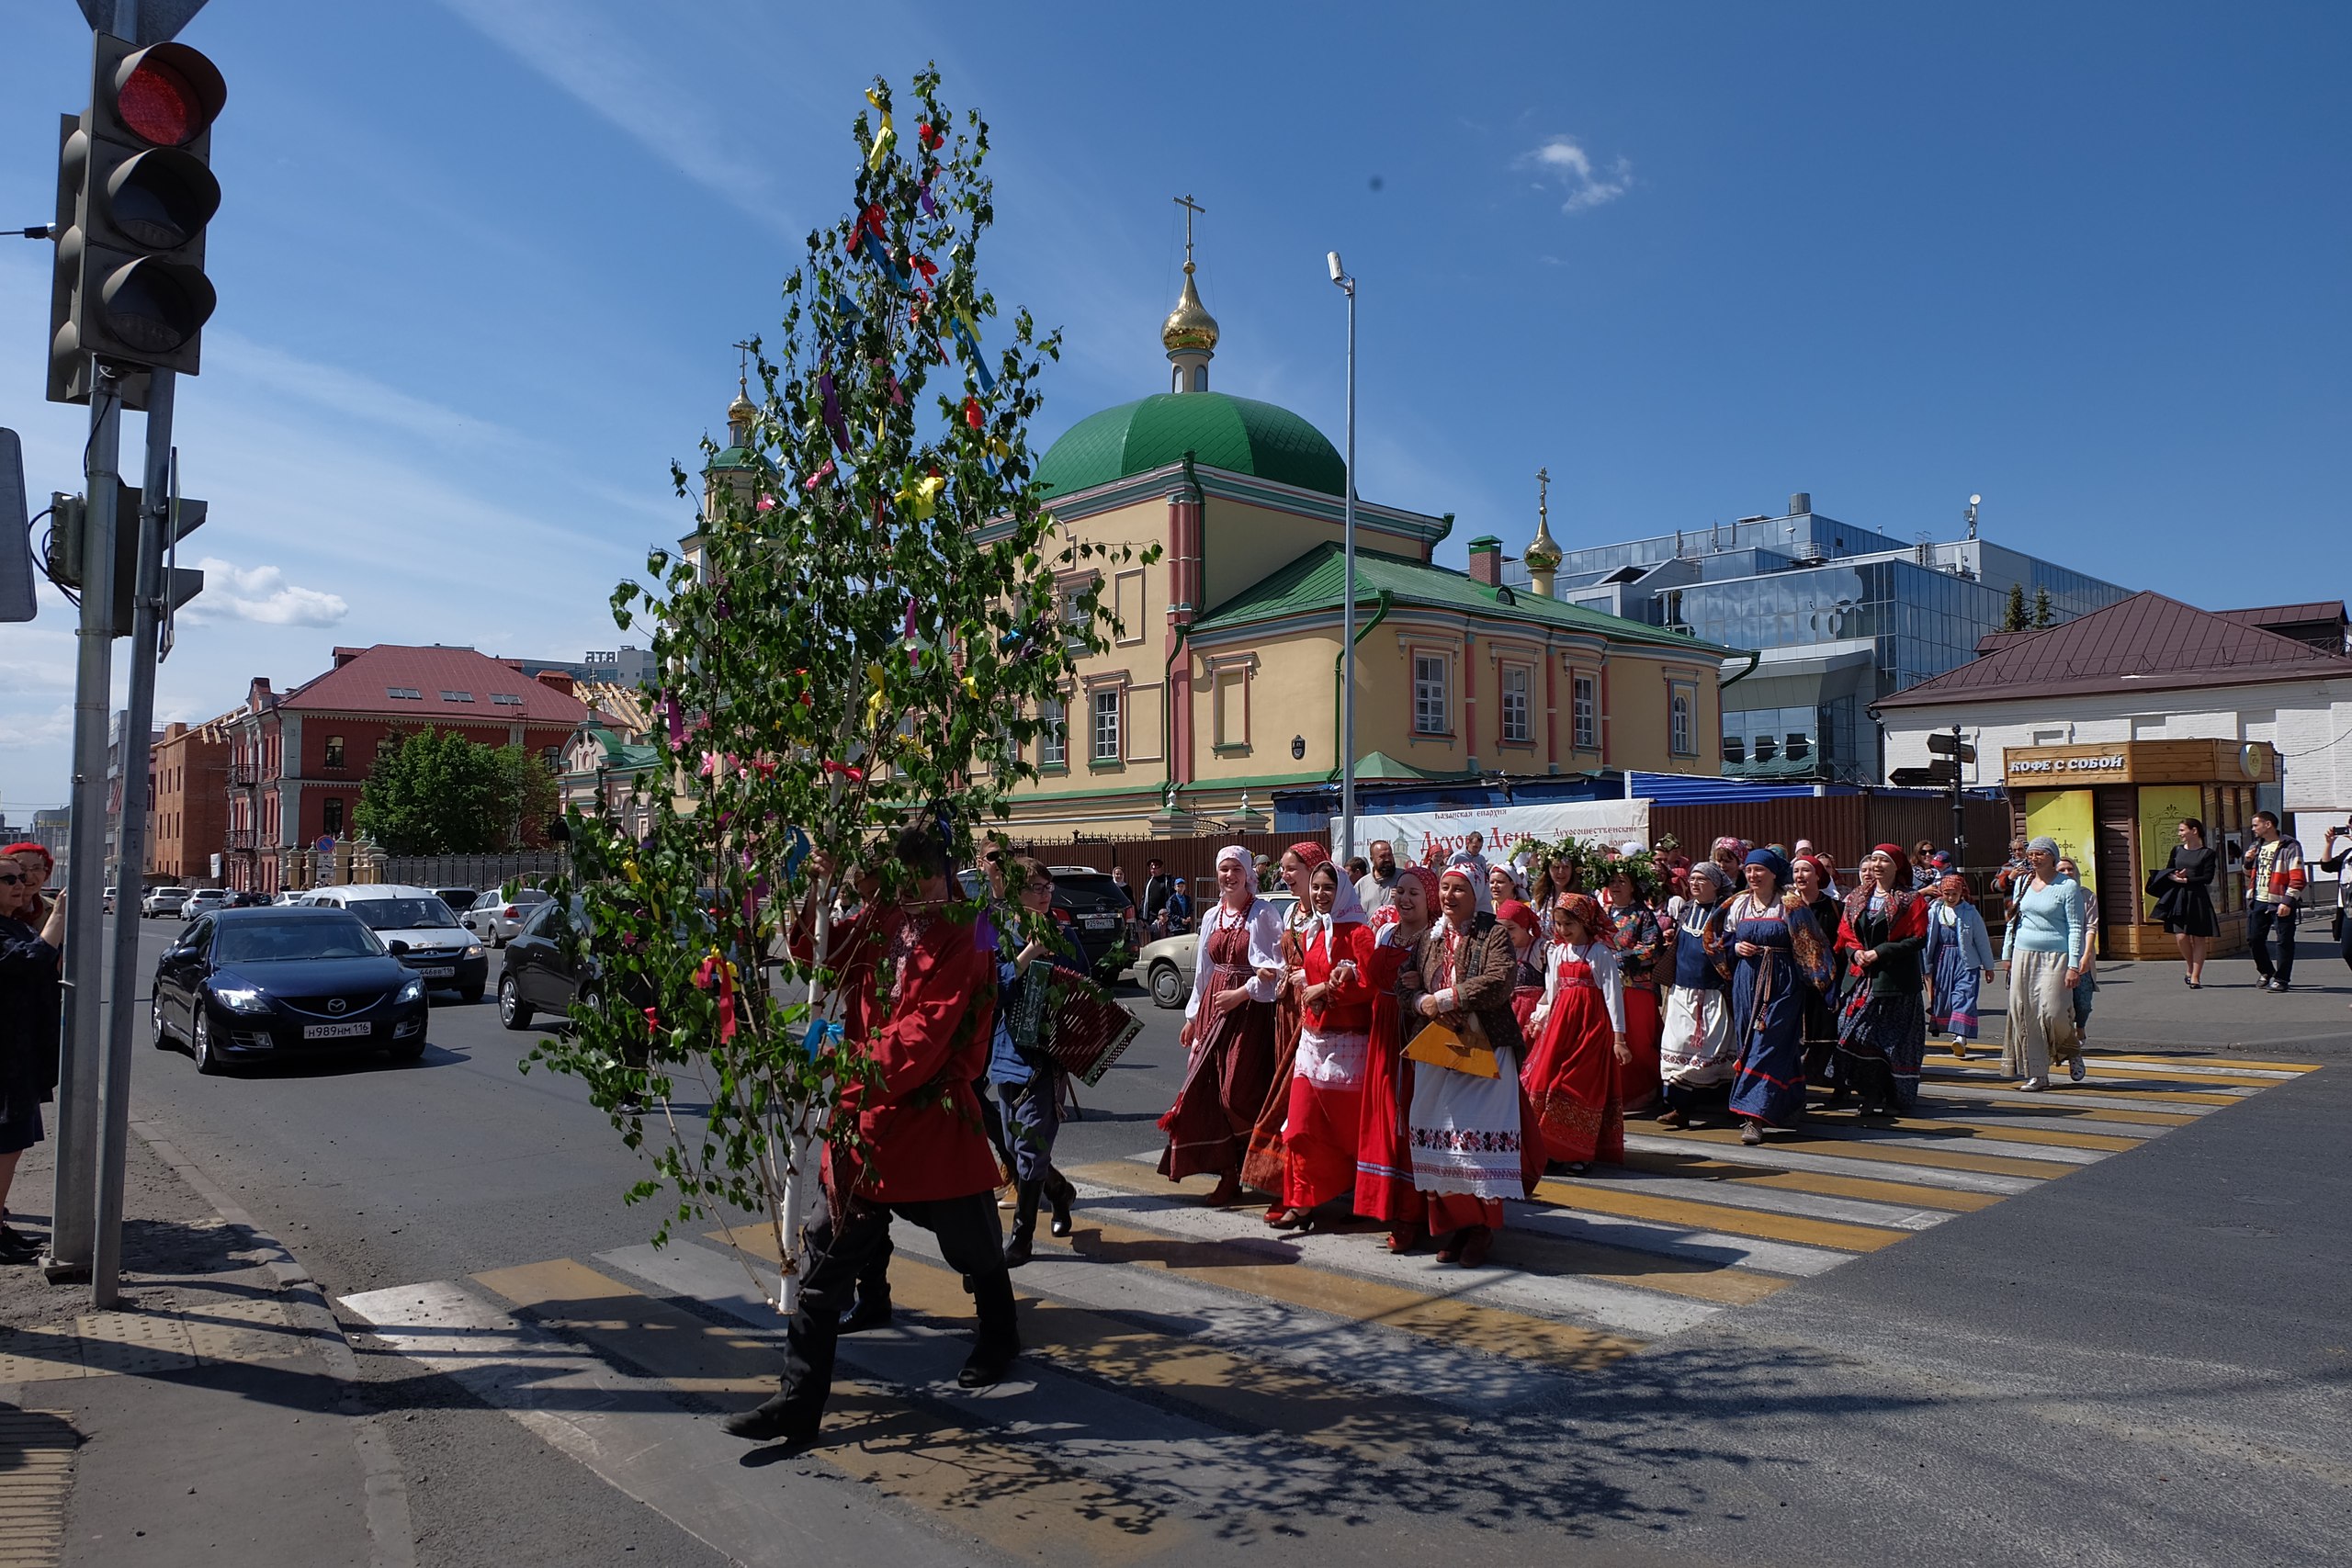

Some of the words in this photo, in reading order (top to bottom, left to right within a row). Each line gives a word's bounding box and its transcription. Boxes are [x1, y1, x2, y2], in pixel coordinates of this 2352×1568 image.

[2008, 761, 2052, 773] КОФЕ
[2053, 760, 2065, 772] С
[2067, 754, 2124, 771] СОБОЙ
[308, 1025, 351, 1037] Н989НМ
[353, 1022, 368, 1032] 116
